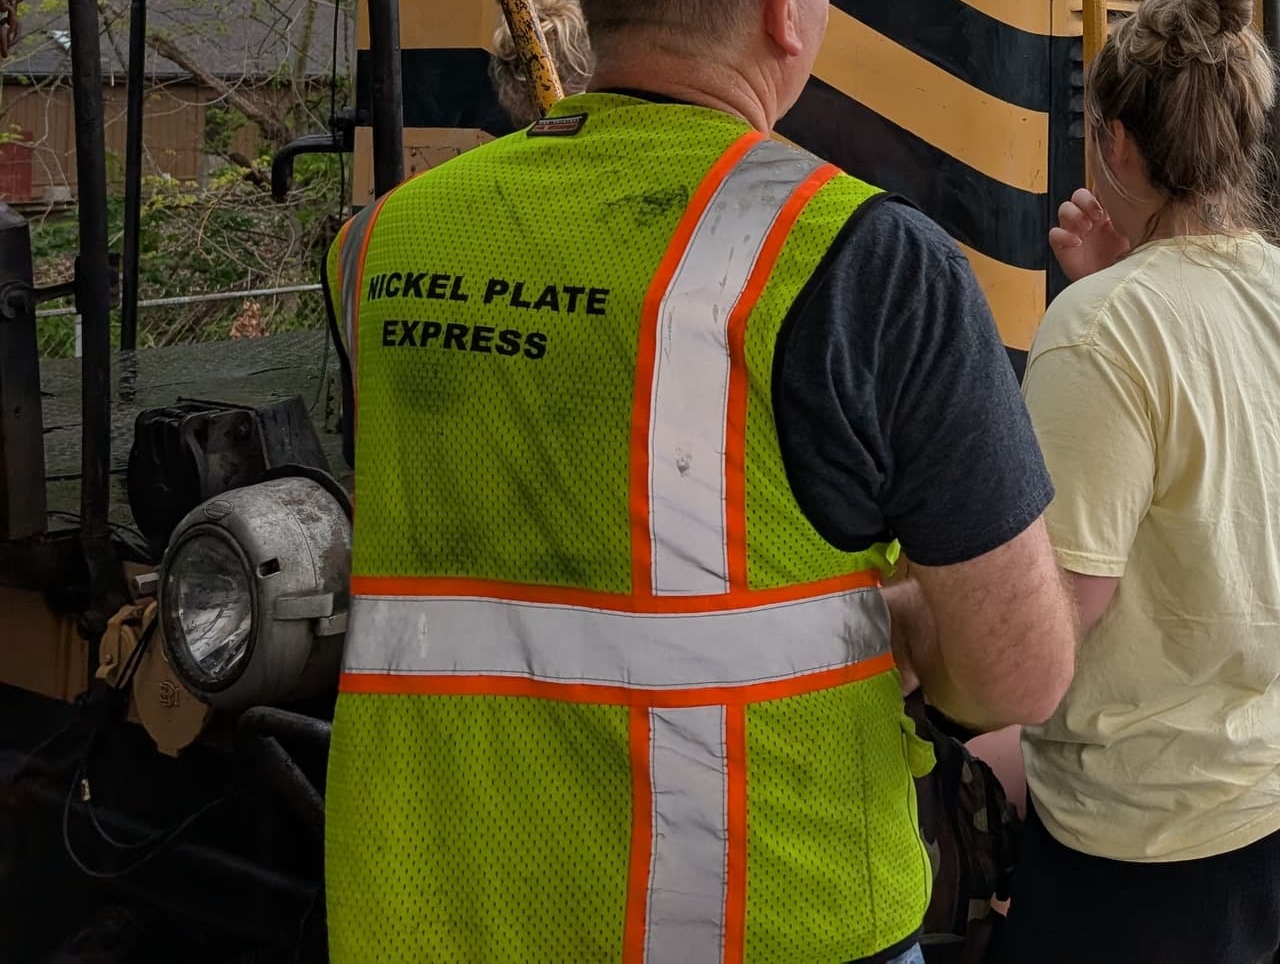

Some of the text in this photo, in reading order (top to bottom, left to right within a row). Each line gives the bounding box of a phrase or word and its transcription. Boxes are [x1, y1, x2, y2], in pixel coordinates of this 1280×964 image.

[368, 272, 610, 316] NICKEL PLATE
[383, 320, 547, 360] EXPRESS
